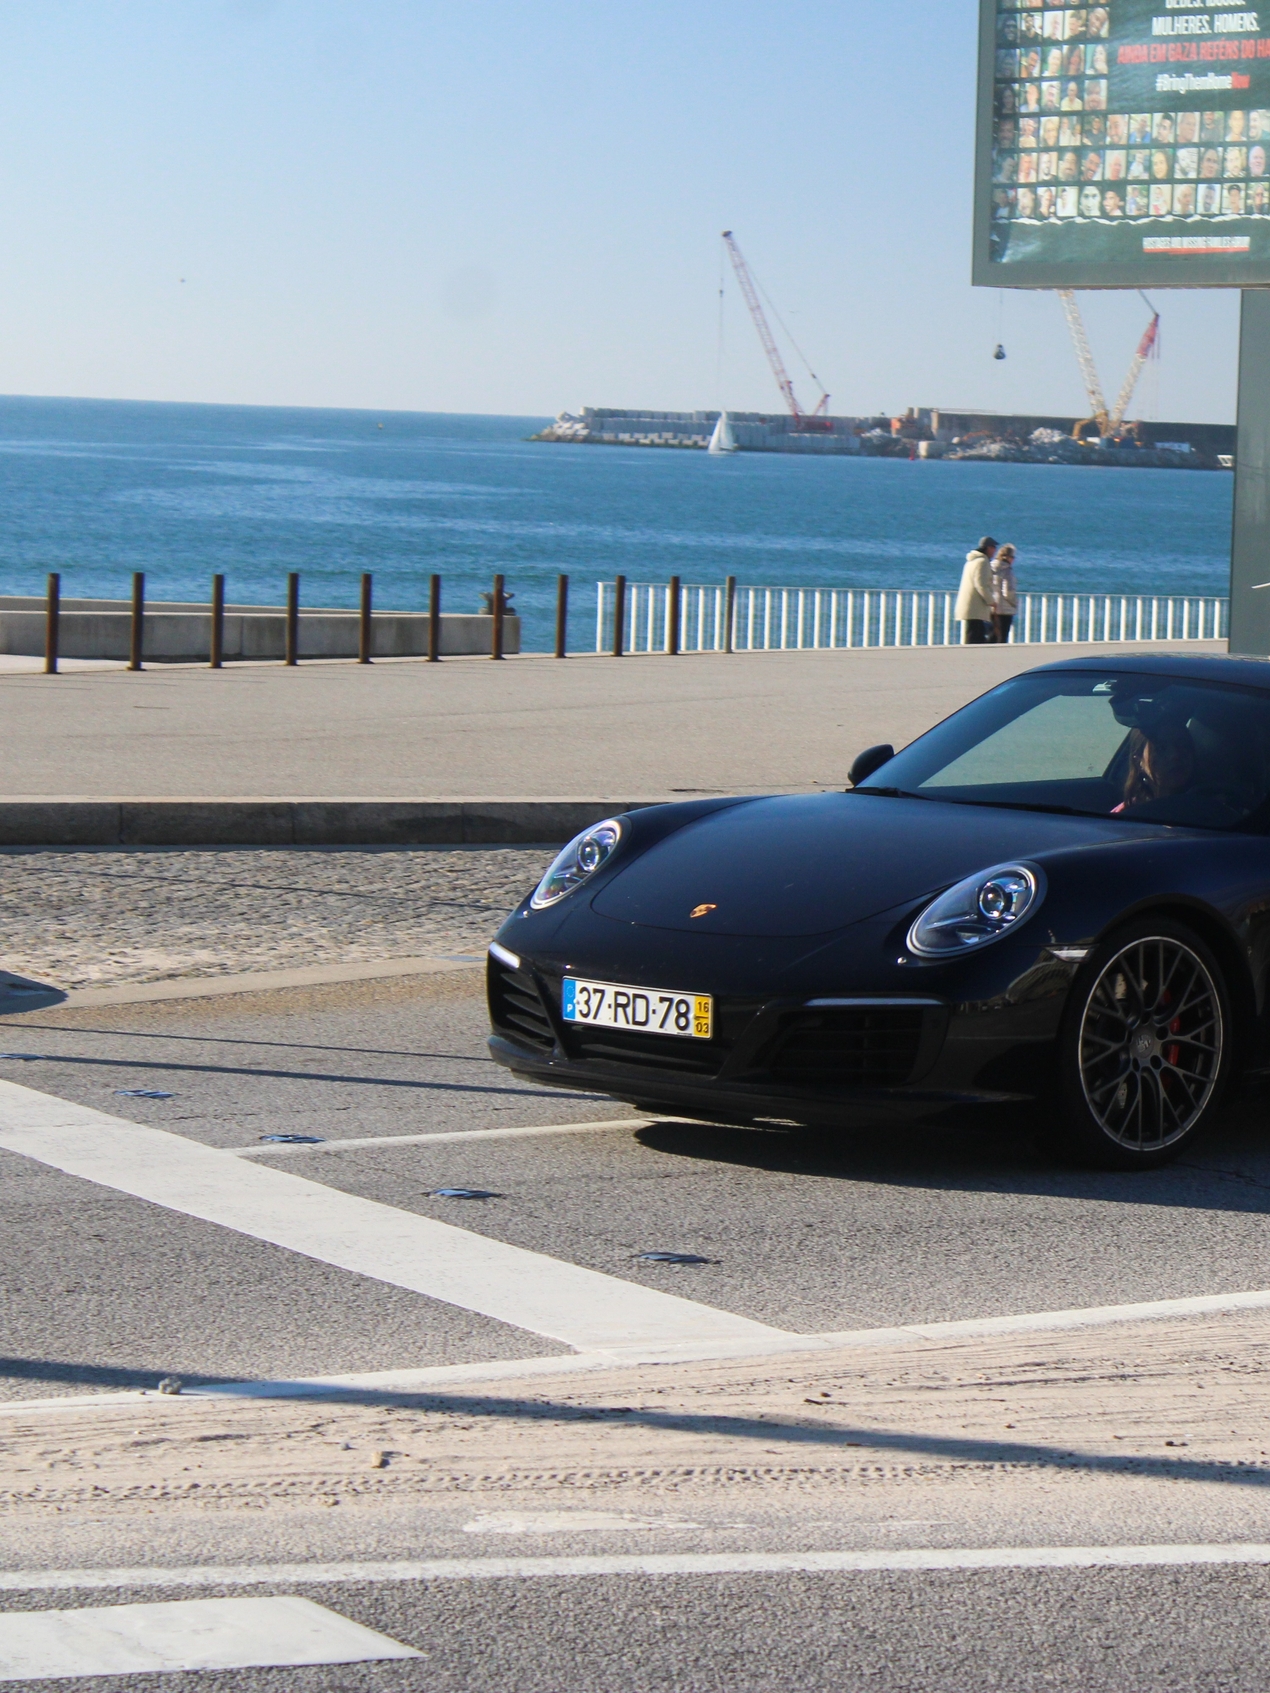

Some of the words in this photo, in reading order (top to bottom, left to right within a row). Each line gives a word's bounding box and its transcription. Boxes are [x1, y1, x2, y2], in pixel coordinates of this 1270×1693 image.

[1152, 15, 1212, 35] MULHERES.
[1214, 12, 1260, 33] HOMENS.
[1117, 44, 1148, 64] AINDA
[1150, 43, 1167, 63] EM
[1168, 42, 1197, 62] GAZA
[1200, 38, 1239, 61] REFÉNS
[1241, 40, 1254, 59] DO
[566, 1003, 574, 1013] P
[697, 1001, 709, 1013] 16
[695, 1022, 709, 1033] 03
